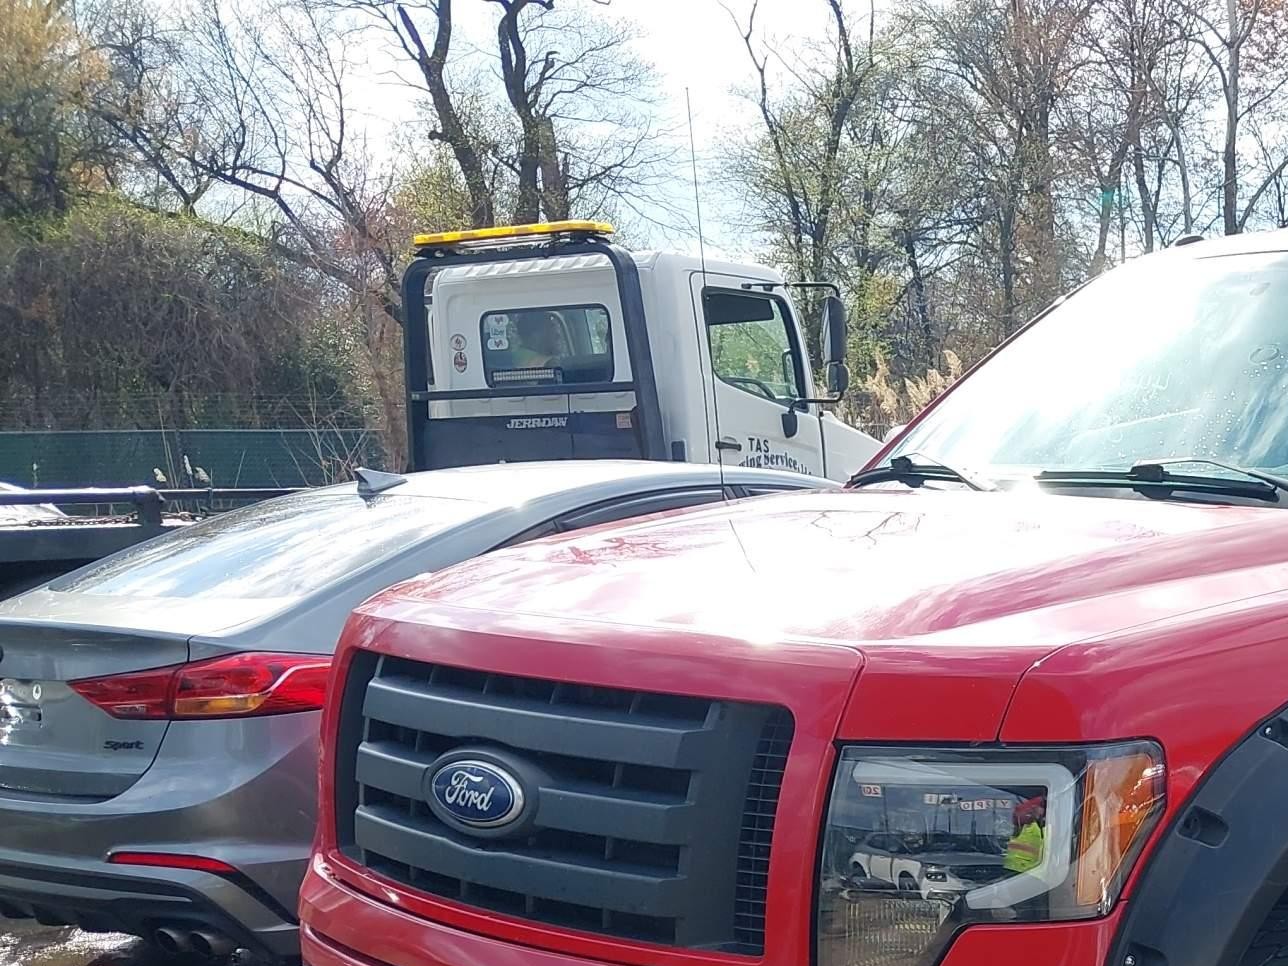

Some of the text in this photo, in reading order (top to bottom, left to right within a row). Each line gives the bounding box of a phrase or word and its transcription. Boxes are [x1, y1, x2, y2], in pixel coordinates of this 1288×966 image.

[748, 437, 769, 453] TAS
[104, 740, 145, 751] Sport
[445, 770, 496, 812] Ford
